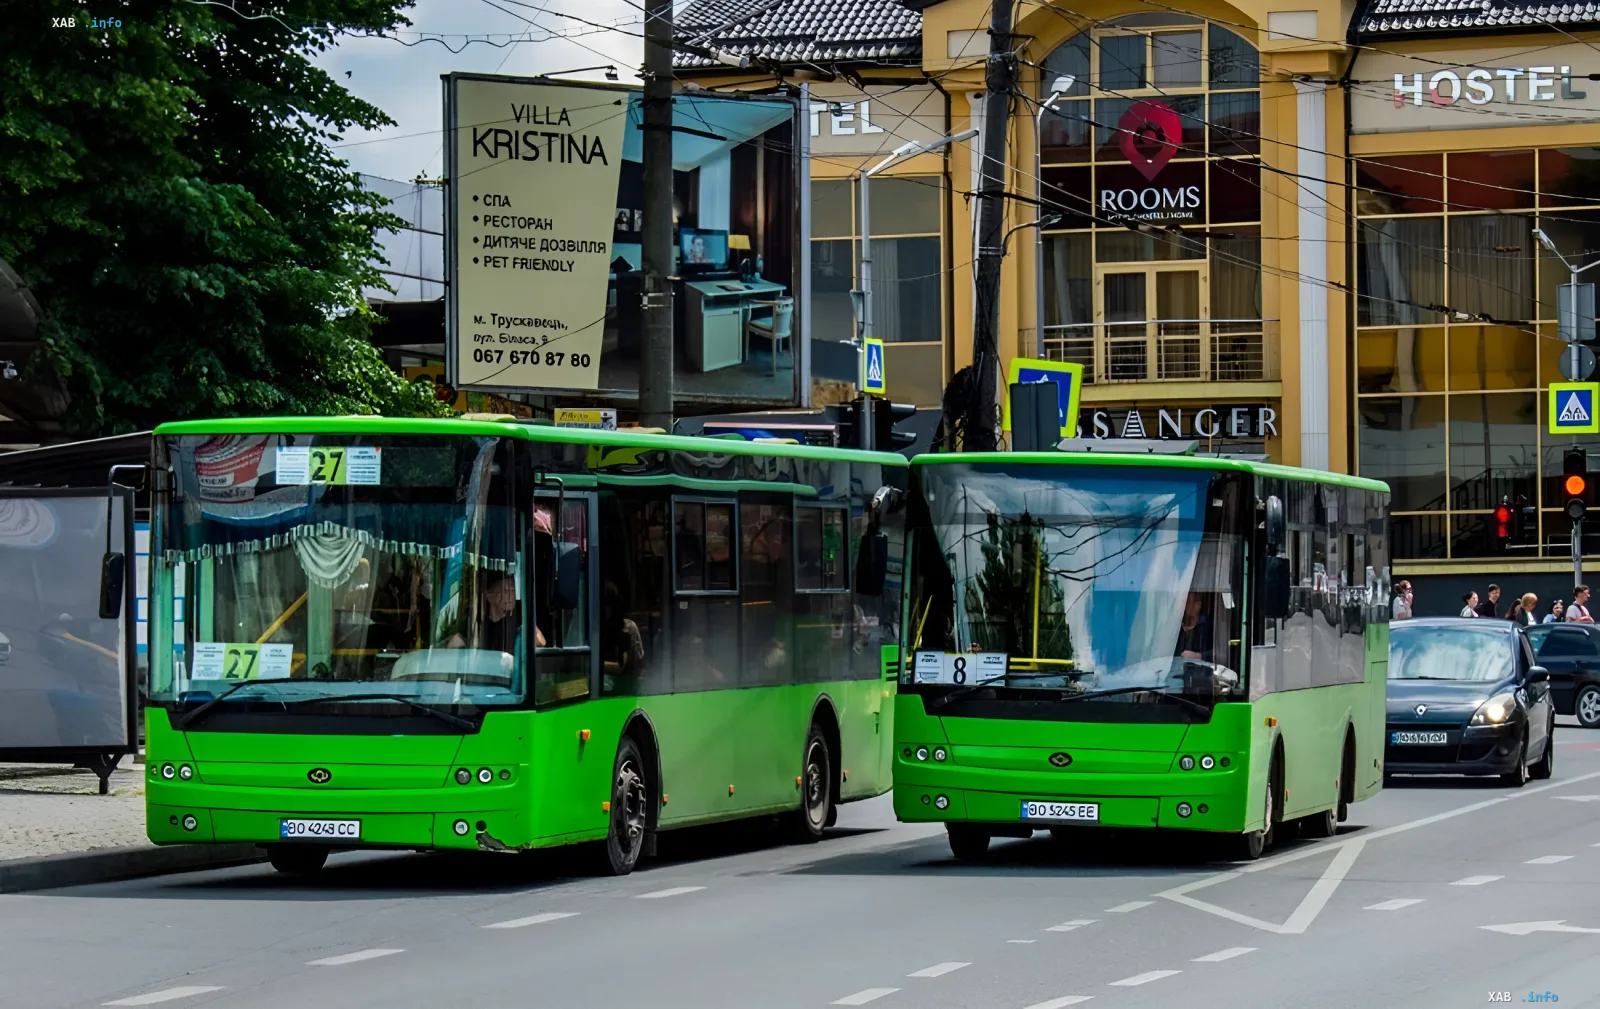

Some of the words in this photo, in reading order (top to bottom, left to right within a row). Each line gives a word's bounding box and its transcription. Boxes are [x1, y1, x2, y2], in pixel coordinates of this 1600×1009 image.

[1393, 65, 1587, 107] HOSTEL
[511, 102, 572, 127] VILLA
[472, 127, 609, 166] KRISTINA
[483, 193, 512, 207] СПА
[1101, 185, 1201, 211] ROOMS
[483, 214, 553, 230] РЕСТОРАН
[482, 234, 537, 250] ДИТЯЧЕ
[483, 255, 509, 268] PET
[512, 257, 575, 272] FRIENDLY
[473, 348, 504, 364] 067
[509, 349, 540, 365] 670
[545, 351, 565, 366] 87
[570, 353, 591, 367] 80
[311, 450, 344, 483] 27
[225, 648, 259, 679] 27
[952, 656, 967, 685] 8
